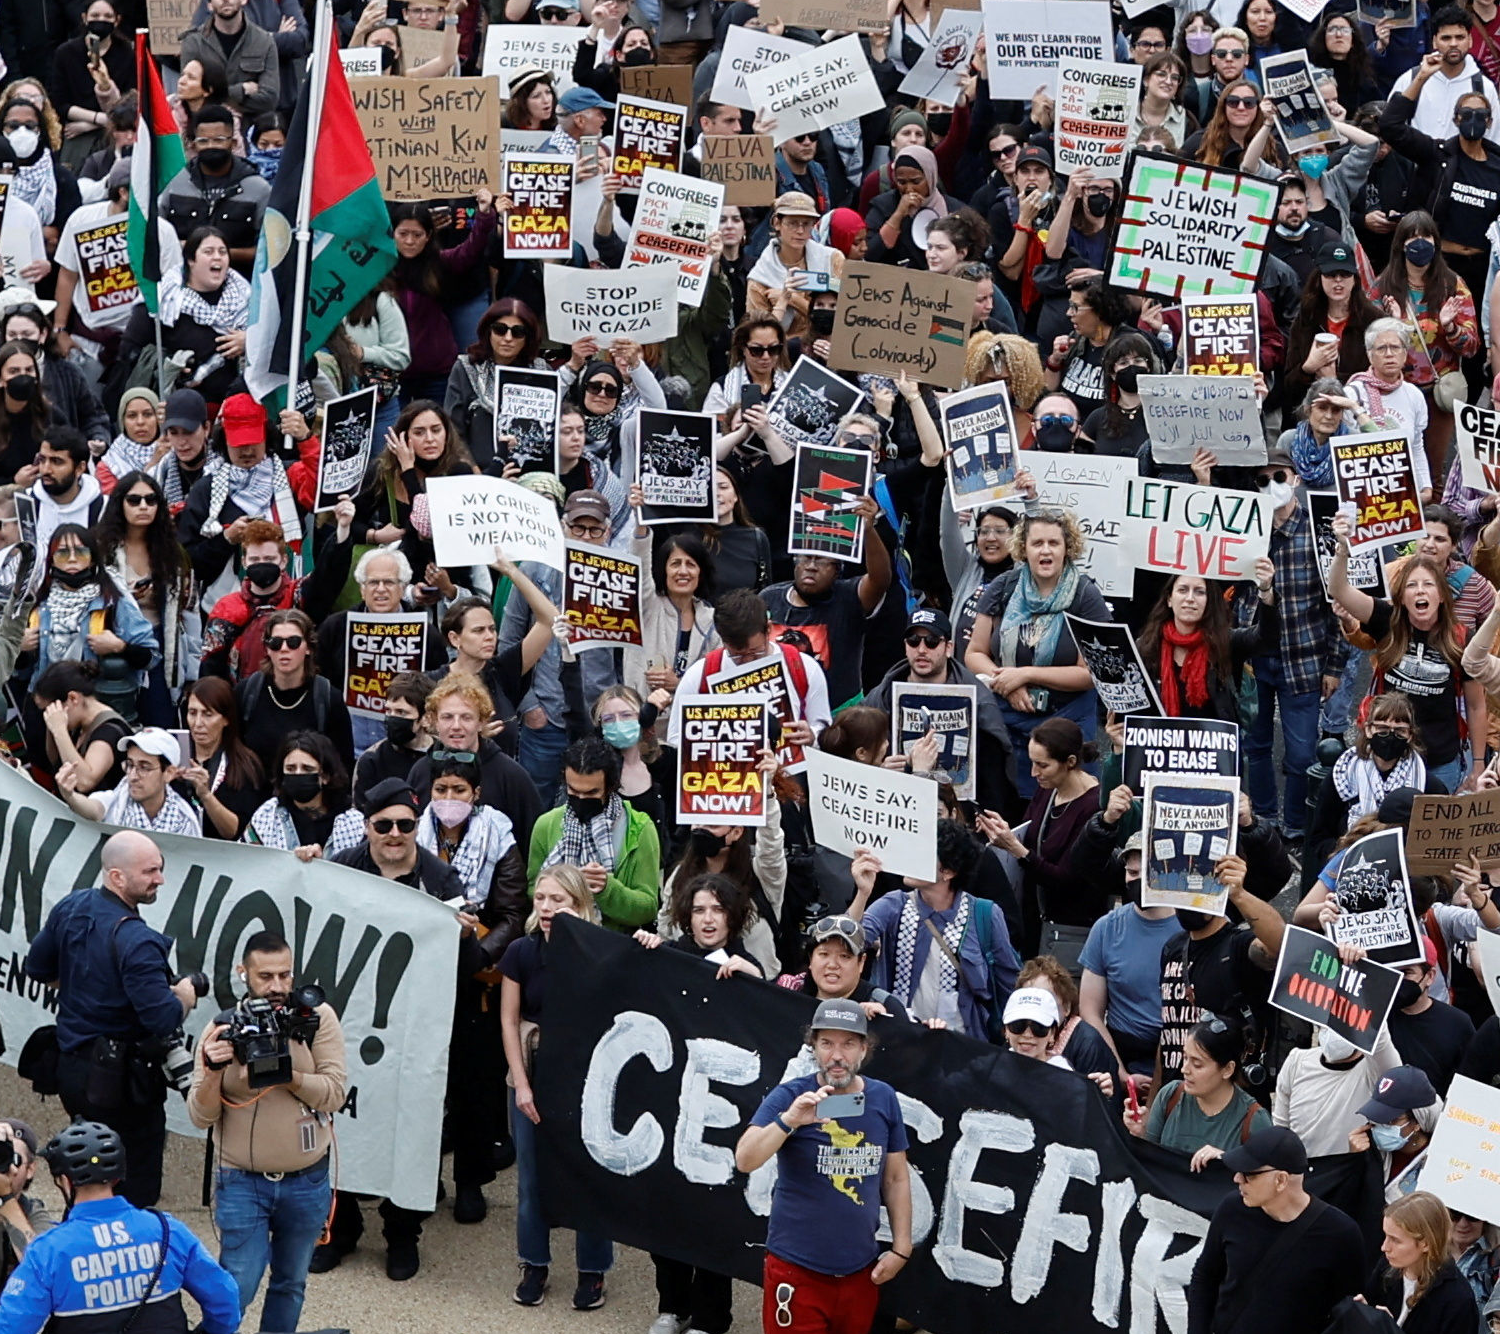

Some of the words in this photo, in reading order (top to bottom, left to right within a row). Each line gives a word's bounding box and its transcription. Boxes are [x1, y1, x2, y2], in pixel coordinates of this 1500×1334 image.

[1161, 189, 1237, 219] JEWISH
[1146, 210, 1246, 243] SOLIDARITY
[1175, 232, 1206, 245] WITH
[1141, 240, 1237, 271] PALESTINE
[586, 286, 637, 300] STOP
[560, 297, 662, 317] GENOCIDE
[572, 318, 591, 333] IN
[598, 316, 651, 334] GAZA
[1125, 480, 1178, 523] LET
[1184, 491, 1264, 537] GAZA
[1147, 526, 1248, 577] LIVE
[1126, 727, 1184, 748] ZIONISM
[1188, 730, 1237, 752] WANTS
[1145, 749, 1166, 768] TO
[1169, 750, 1217, 770] ERASE
[164, 865, 417, 1067] NOW!
